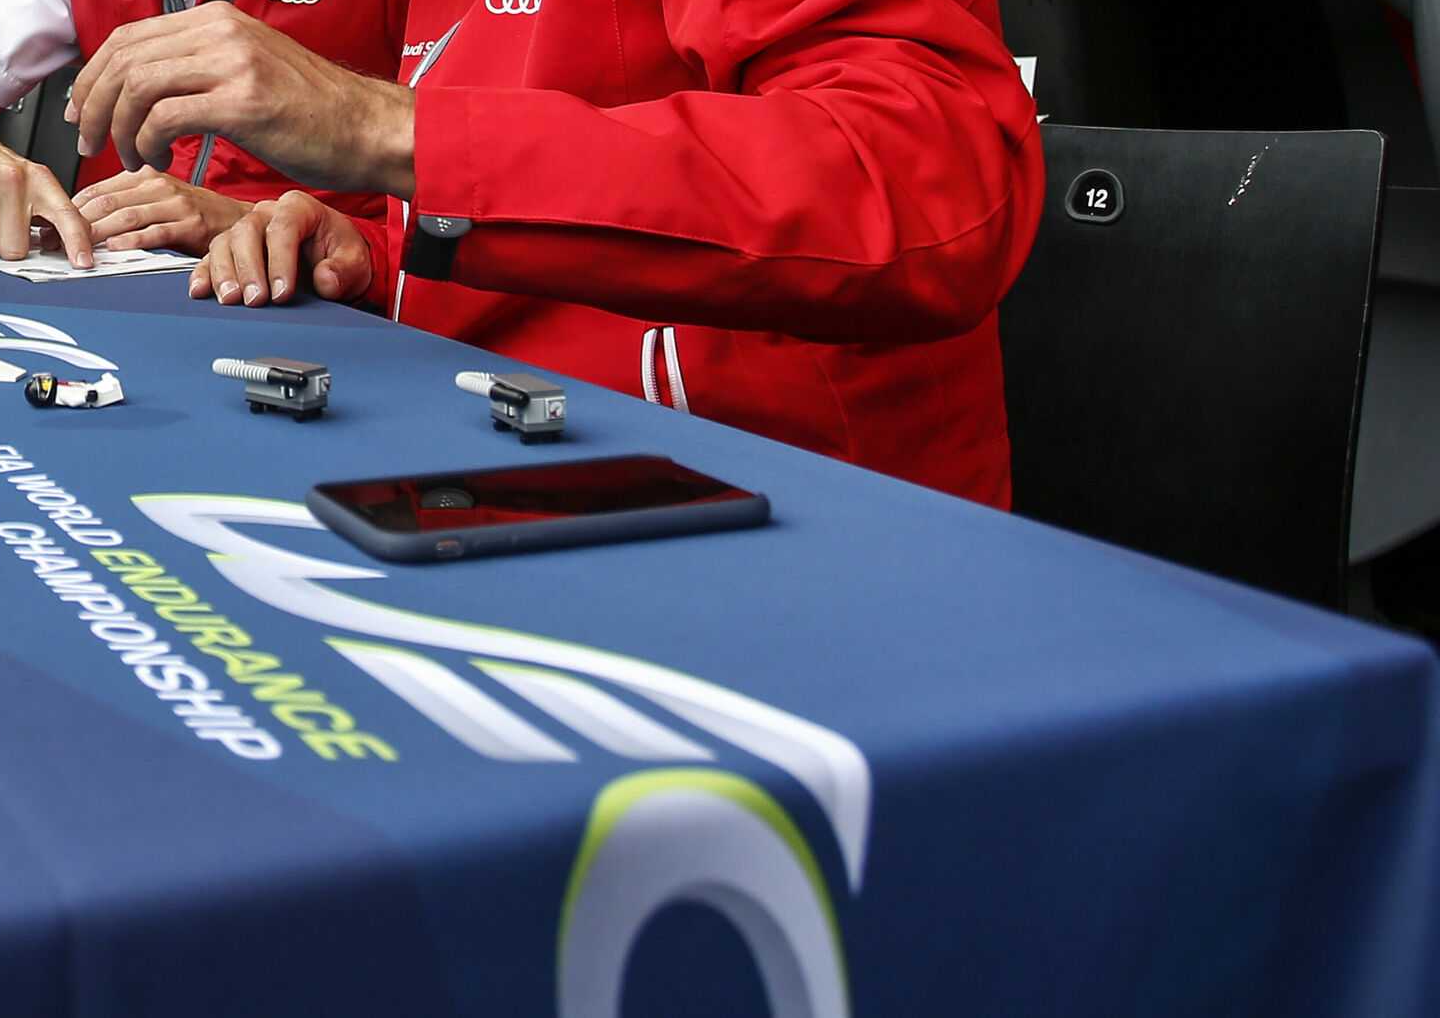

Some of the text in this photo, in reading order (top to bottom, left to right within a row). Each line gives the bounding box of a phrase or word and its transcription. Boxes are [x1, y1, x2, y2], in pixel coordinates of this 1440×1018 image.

[1086, 188, 1108, 208] 12
[7, 473, 124, 547] WORLD
[89, 548, 400, 762] ENDURANCE
